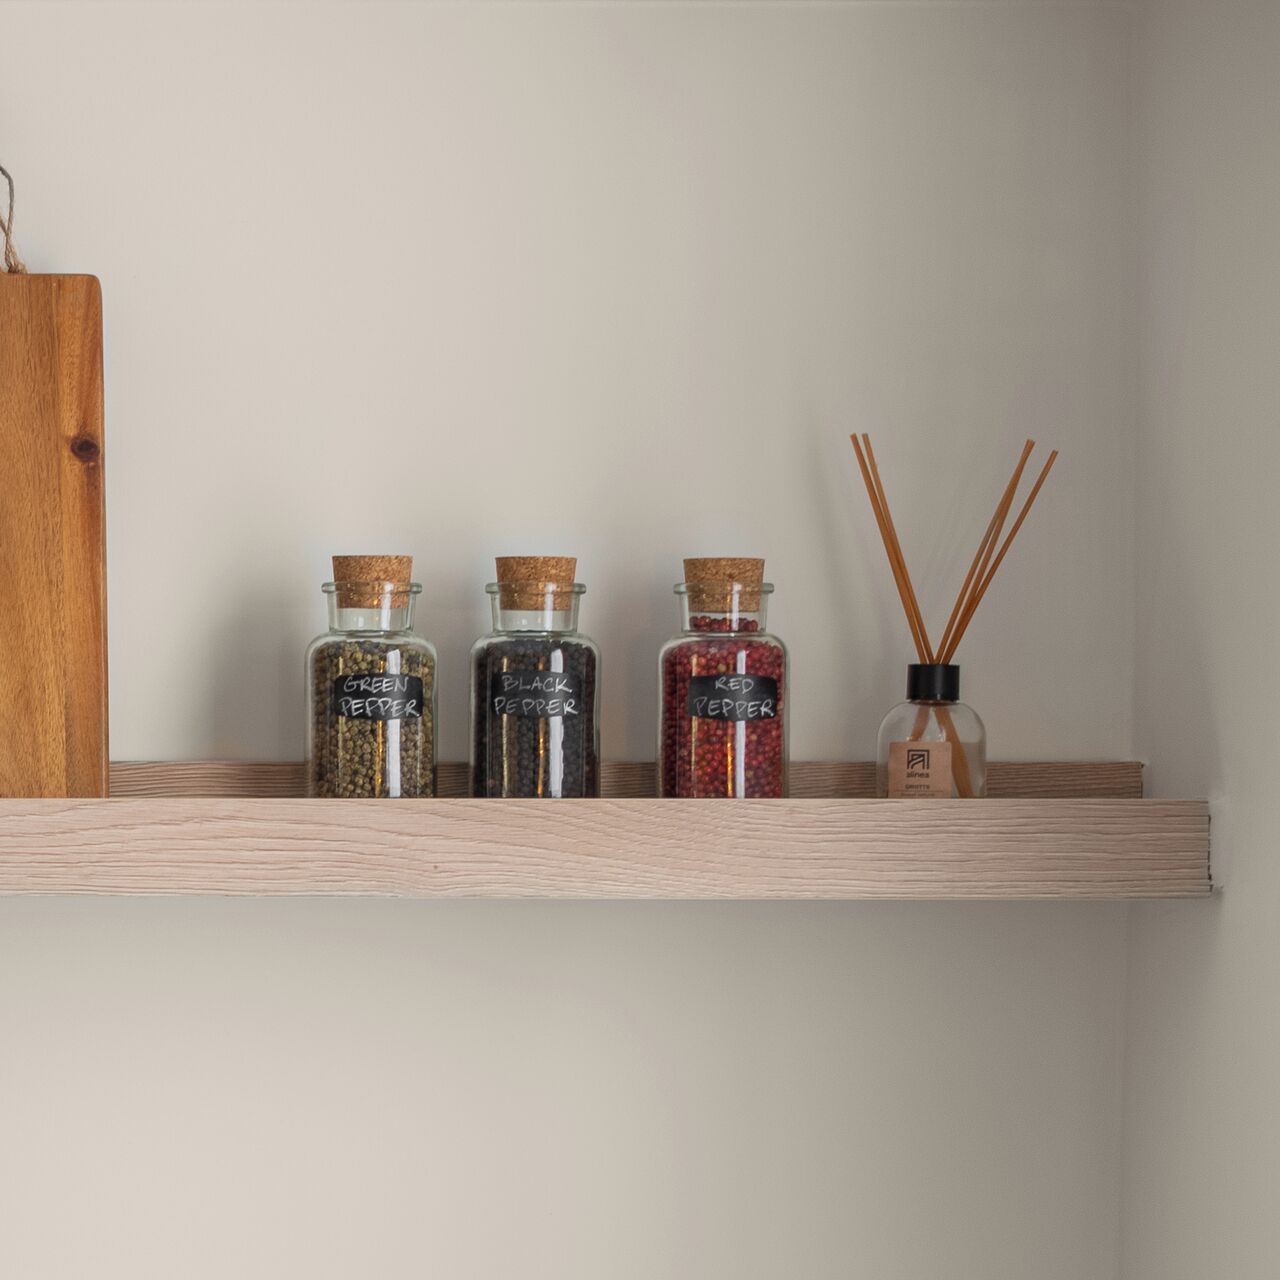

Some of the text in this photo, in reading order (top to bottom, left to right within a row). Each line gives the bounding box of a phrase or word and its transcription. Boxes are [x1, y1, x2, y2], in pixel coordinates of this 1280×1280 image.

[343, 676, 409, 694] GREEN
[502, 674, 573, 693] BLACK
[714, 676, 755, 695] RED
[339, 696, 420, 717] PEPPER
[493, 696, 579, 715] PEPPER
[693, 696, 775, 718] PEPPER
[906, 771, 930, 779] alinea
